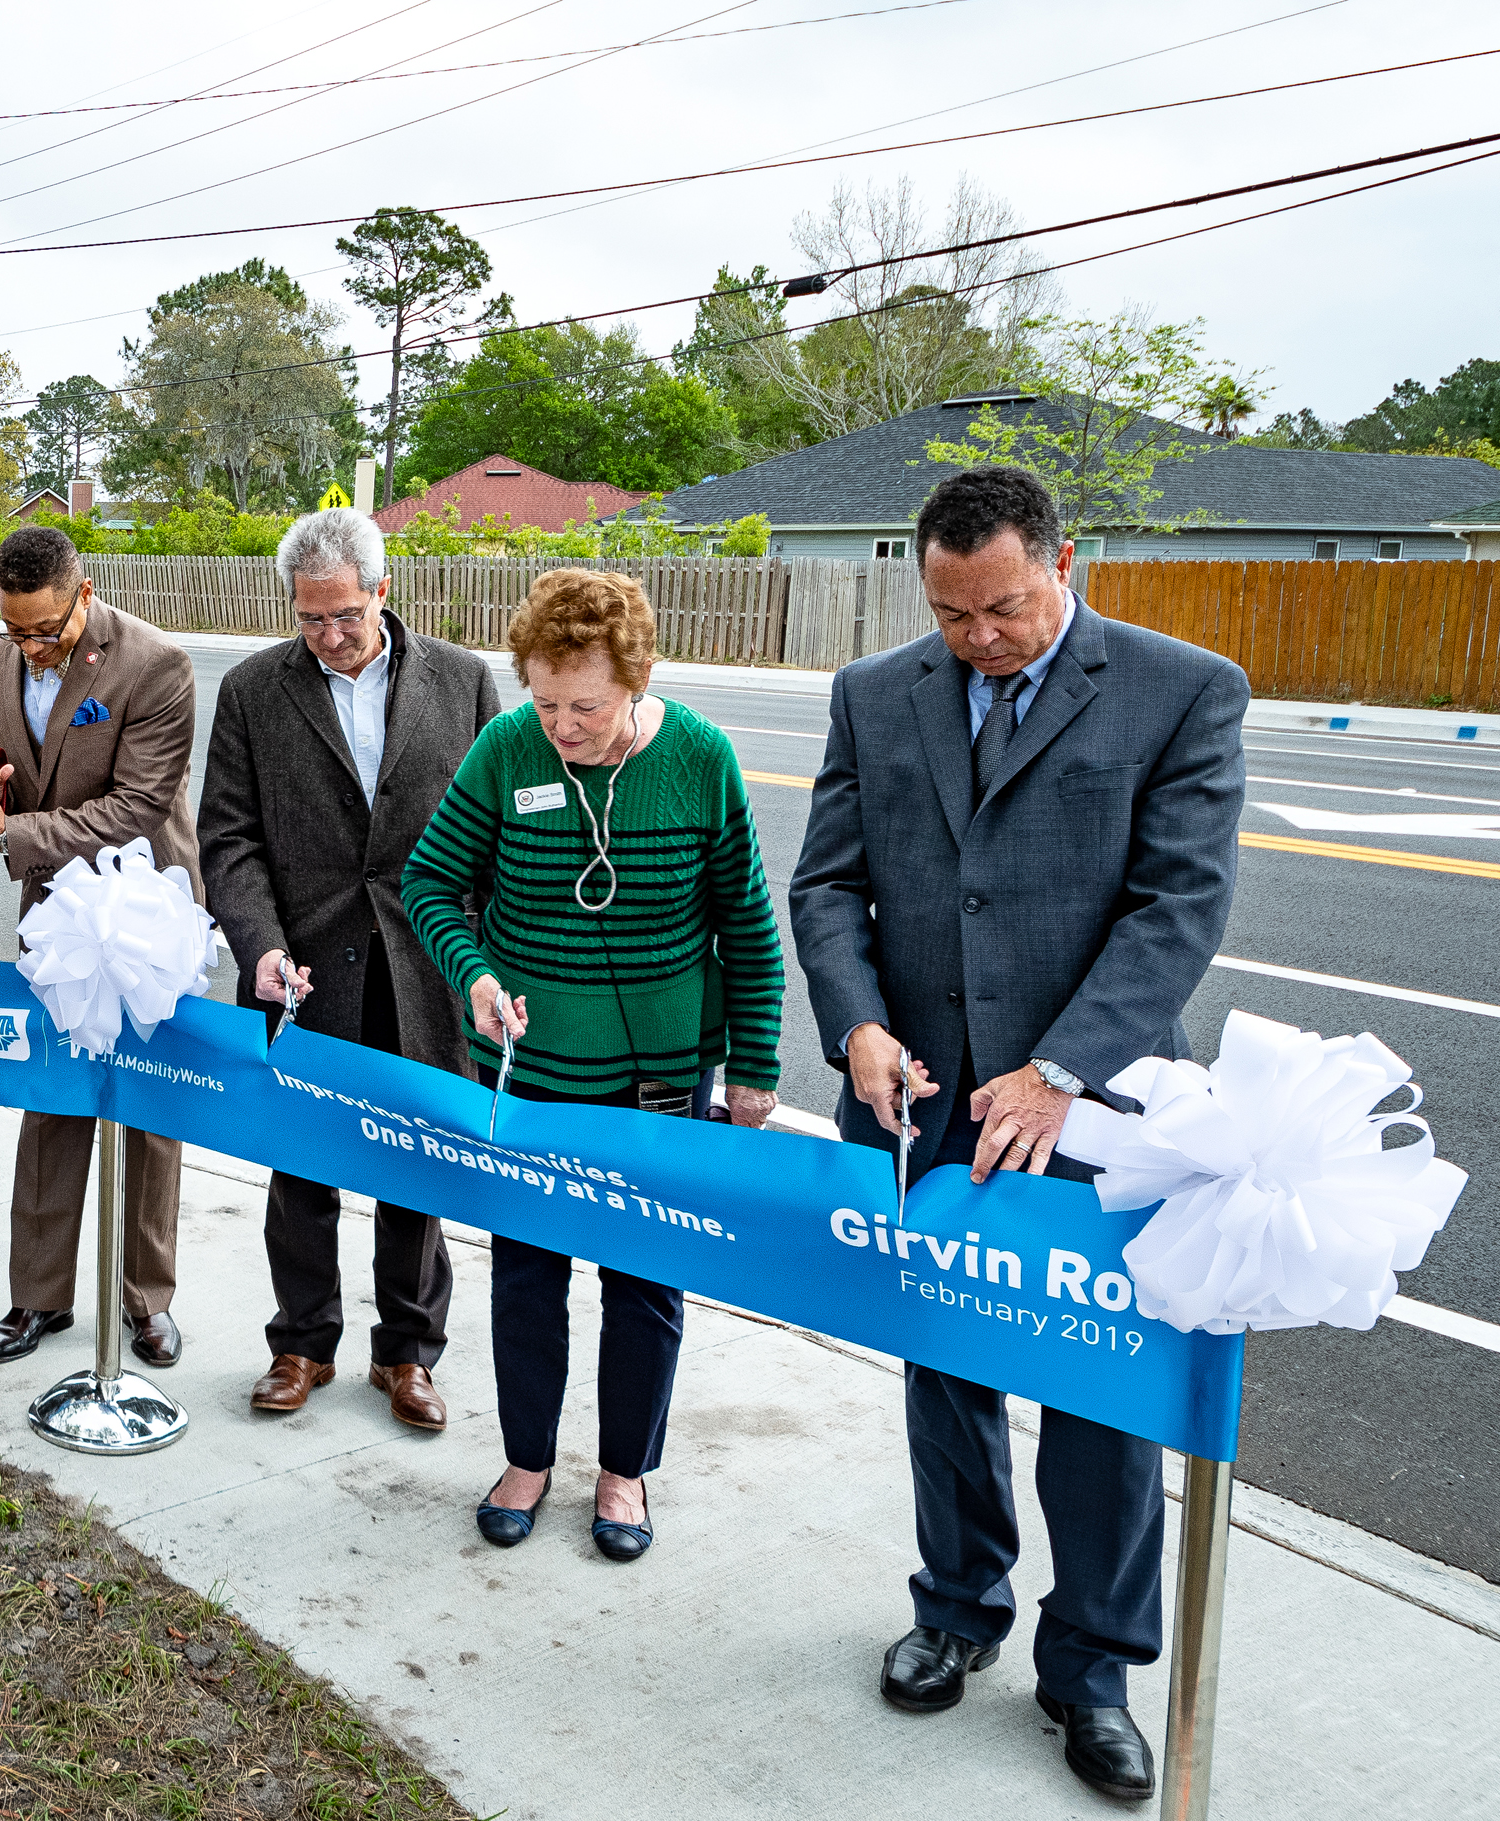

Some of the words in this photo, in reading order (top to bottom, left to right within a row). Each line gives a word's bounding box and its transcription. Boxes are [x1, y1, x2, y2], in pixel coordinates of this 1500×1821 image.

[272, 1067, 413, 1127] Improving
[413, 1117, 639, 1191] Communities.
[360, 1117, 415, 1151] One
[419, 1134, 555, 1195] Roadway
[565, 1179, 599, 1204] at
[606, 1191, 626, 1211] a
[629, 1193, 736, 1242] Time.
[829, 1207, 1023, 1291] Girvin
[1045, 1247, 1134, 1313] Ro
[899, 1270, 1049, 1337] February
[1059, 1314, 1145, 1357] 2019
